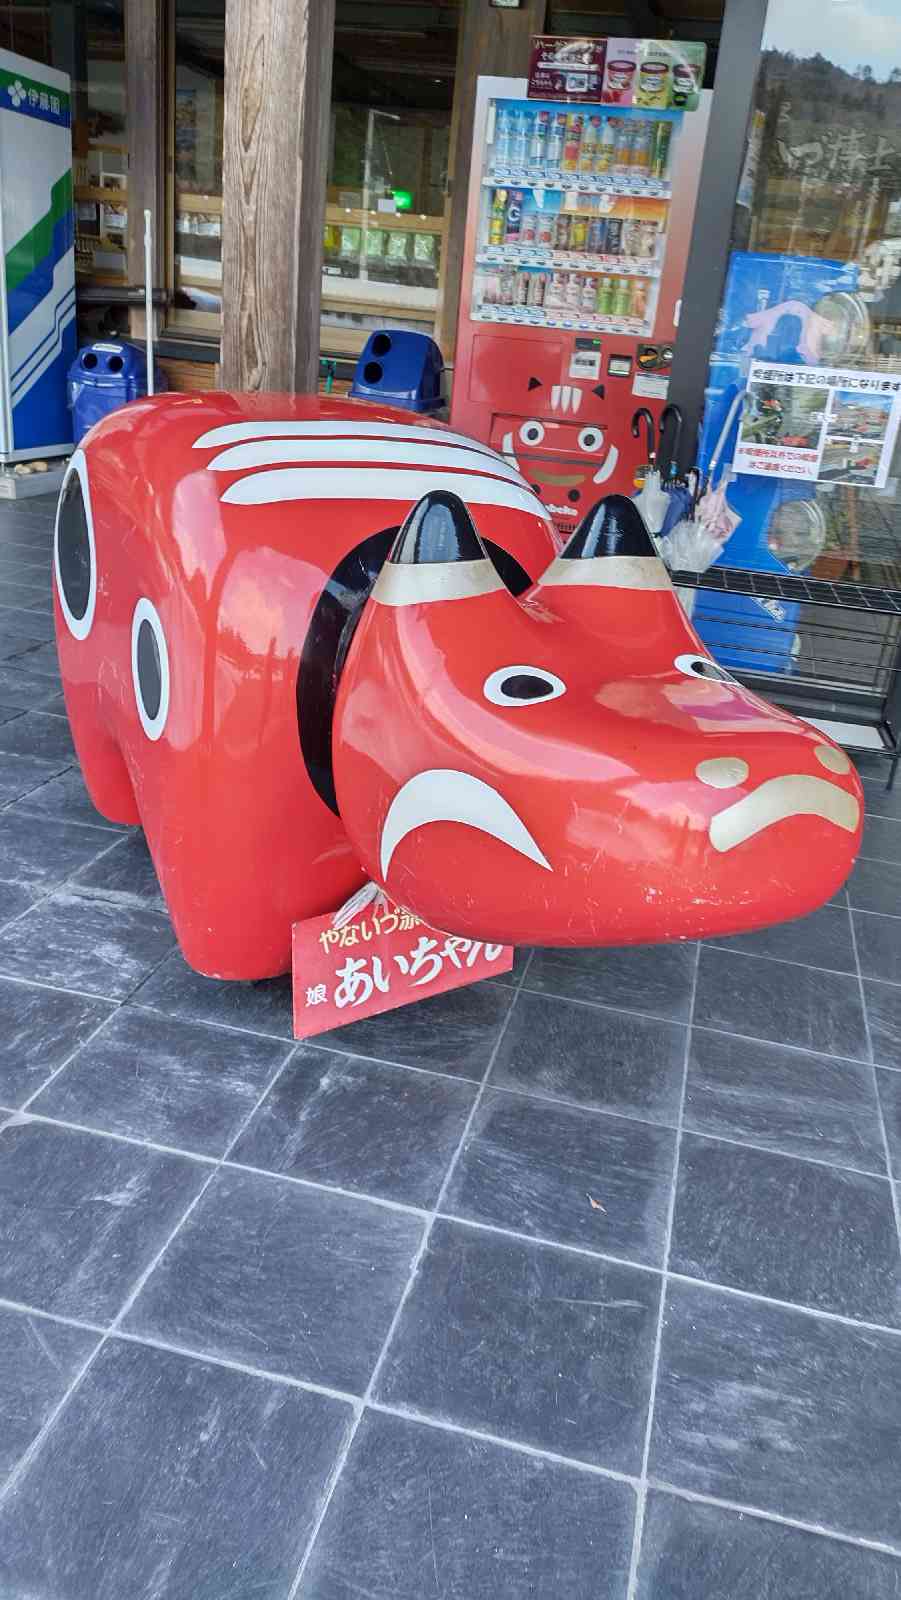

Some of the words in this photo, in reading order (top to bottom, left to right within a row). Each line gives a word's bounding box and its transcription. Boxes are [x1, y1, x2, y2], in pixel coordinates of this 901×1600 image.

[28, 88, 60, 115] 伊藤園
[305, 983, 328, 1007] 娘
[334, 936, 503, 1008] あいちゃん
